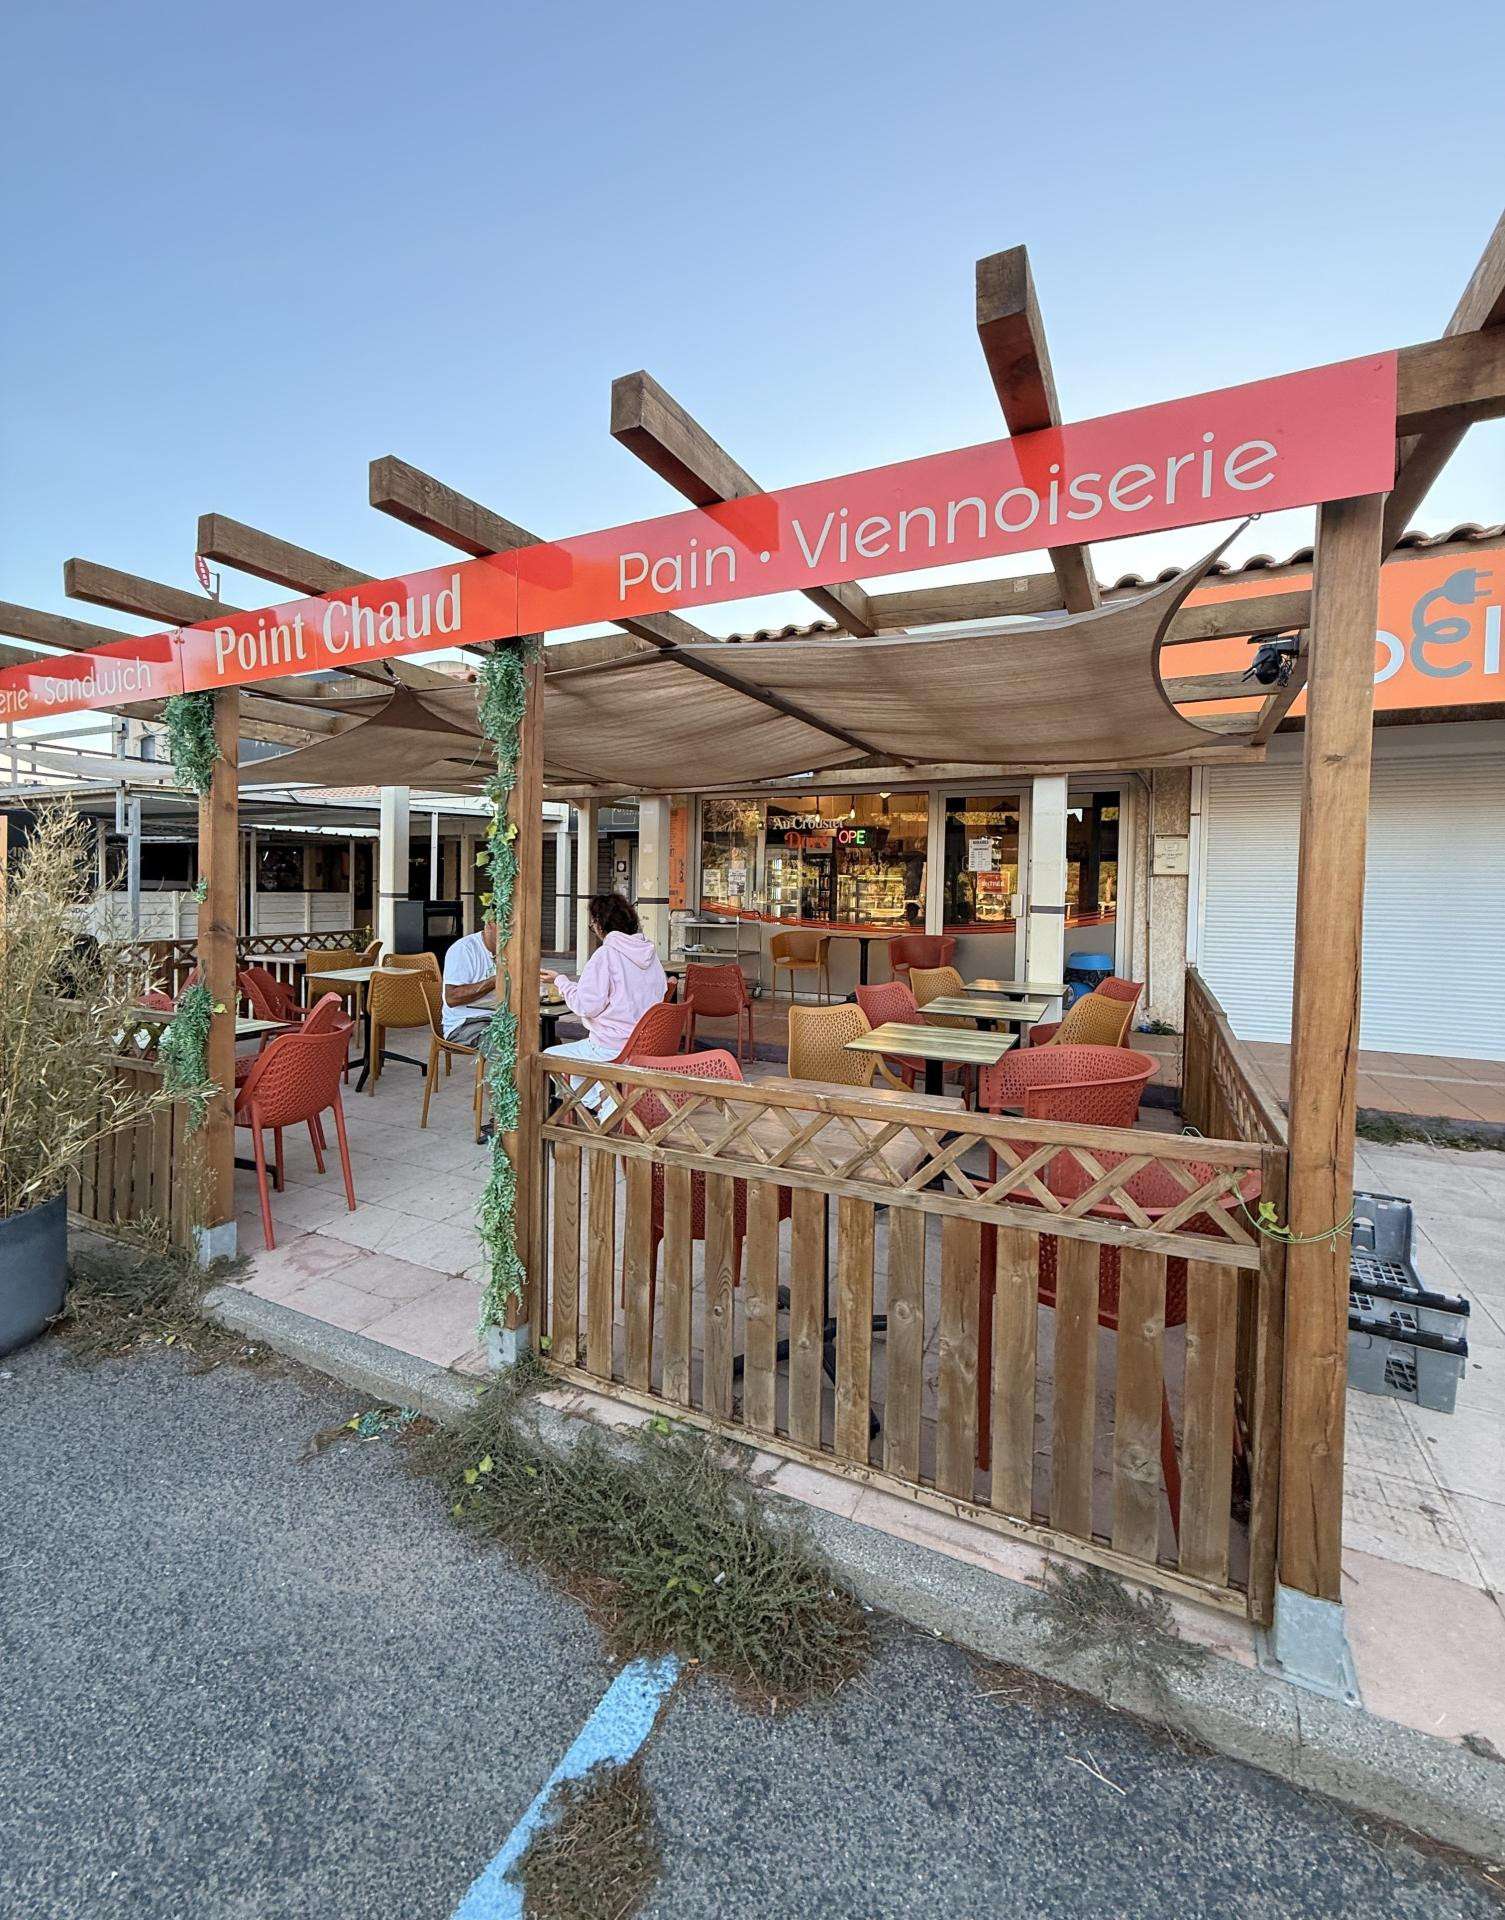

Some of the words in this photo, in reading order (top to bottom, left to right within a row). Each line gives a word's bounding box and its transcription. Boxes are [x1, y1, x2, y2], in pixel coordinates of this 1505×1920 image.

[618, 537, 737, 601] Pain
[792, 431, 1279, 569] Viennoiserie
[213, 610, 307, 675] Point
[322, 572, 463, 654] Chaud
[44, 655, 151, 705] Sandwich
